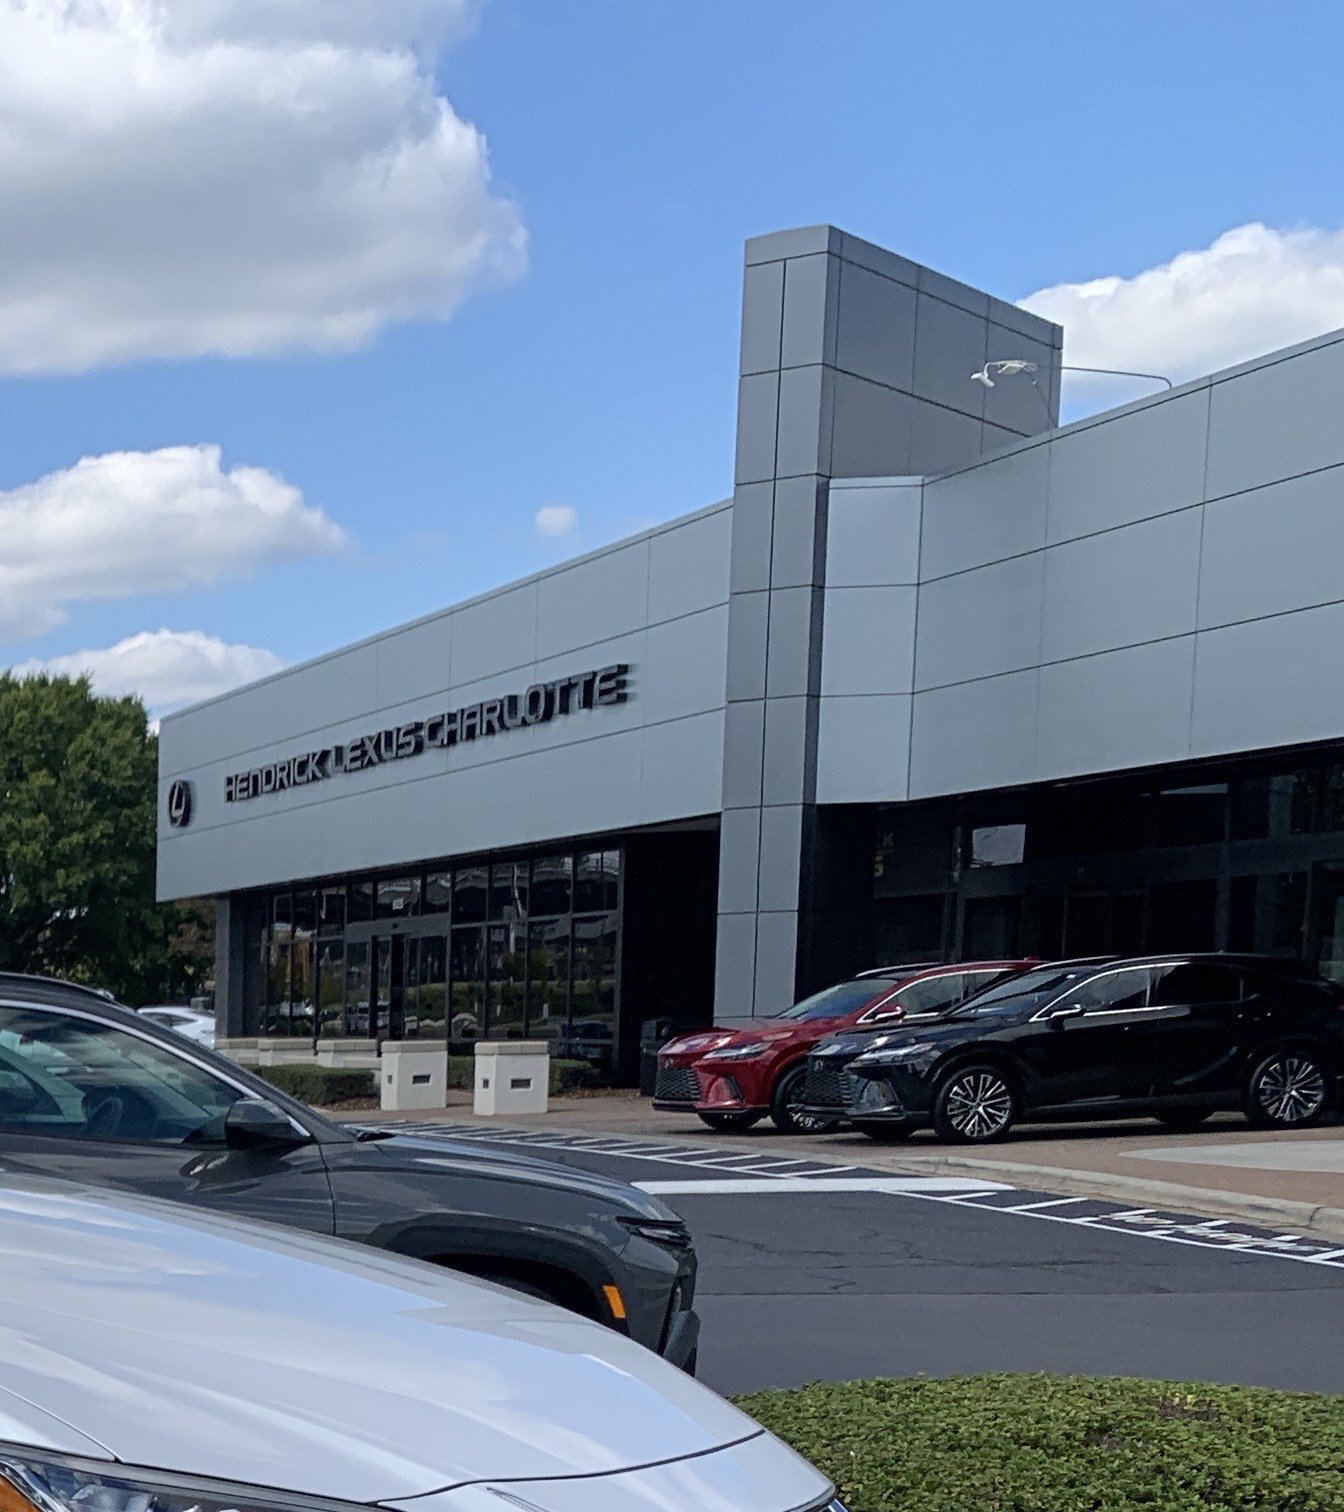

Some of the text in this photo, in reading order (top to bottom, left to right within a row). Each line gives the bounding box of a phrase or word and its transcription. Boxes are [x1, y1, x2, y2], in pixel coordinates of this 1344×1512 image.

[225, 663, 636, 802] HENDRICK LEXUS CHARLOTTE
